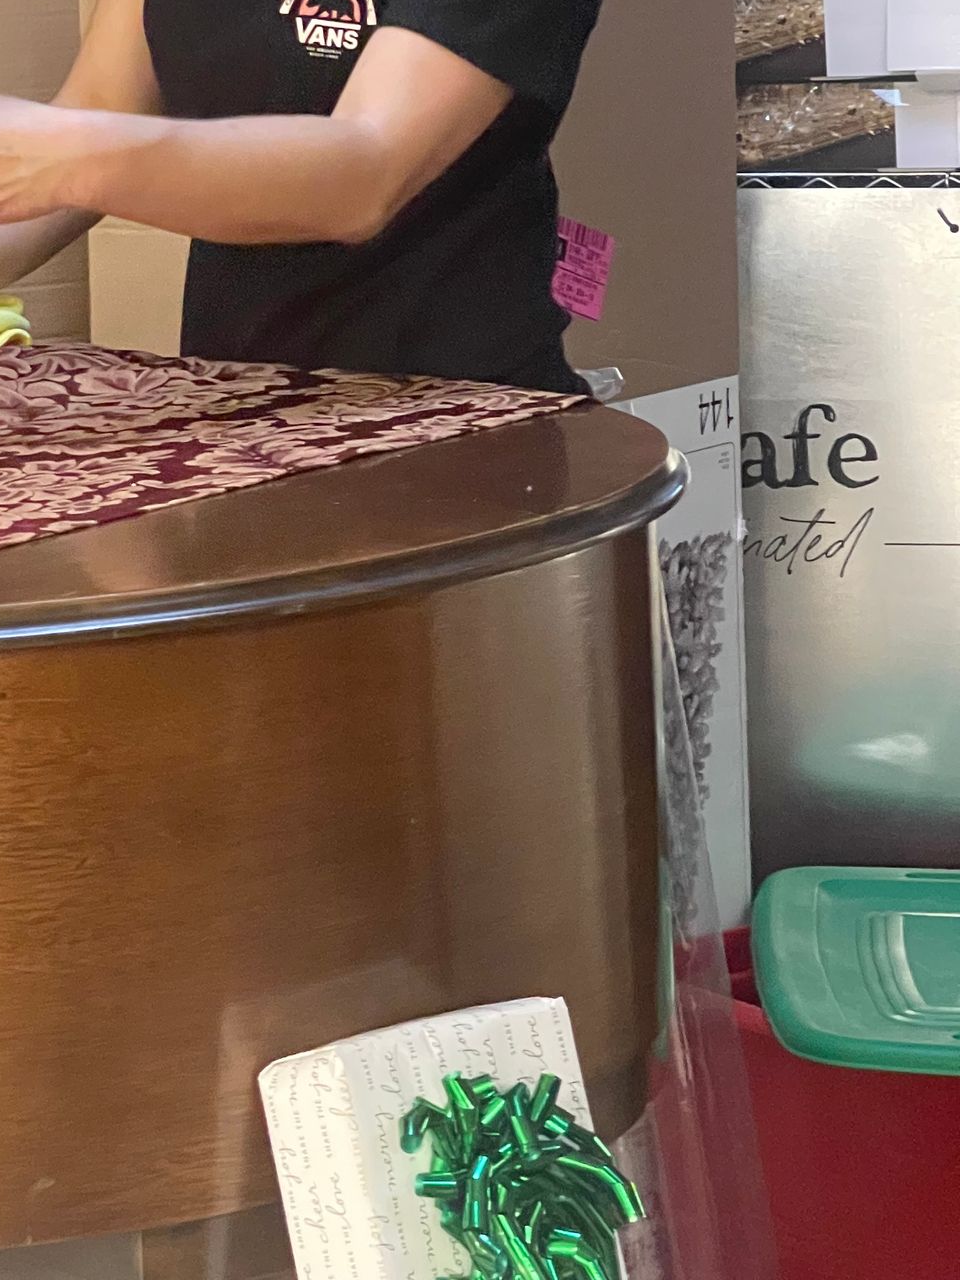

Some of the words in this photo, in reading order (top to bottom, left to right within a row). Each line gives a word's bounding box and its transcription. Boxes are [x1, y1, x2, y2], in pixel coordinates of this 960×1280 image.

[295, 17, 361, 50] VANS
[699, 387, 734, 435] 144
[741, 404, 879, 489] afe
[743, 507, 874, 578] nated
[451, 1022, 481, 1061] joy
[476, 1037, 501, 1086] heer
[522, 1014, 548, 1071] love
[306, 1057, 332, 1098] joy
[380, 1050, 405, 1101] love
[314, 1099, 325, 1119] THE
[327, 1073, 359, 1132] cheer
[278, 1140, 303, 1187] joy
[320, 1124, 333, 1159] SHARE
[374, 1105, 397, 1192] merry
[297, 1181, 329, 1244] cheer
[324, 1171, 352, 1230] love
[341, 1223, 352, 1245] THE
[367, 1208, 396, 1257] joy
[419, 1199, 436, 1263] merr
[347, 1251, 359, 1278] HARE
